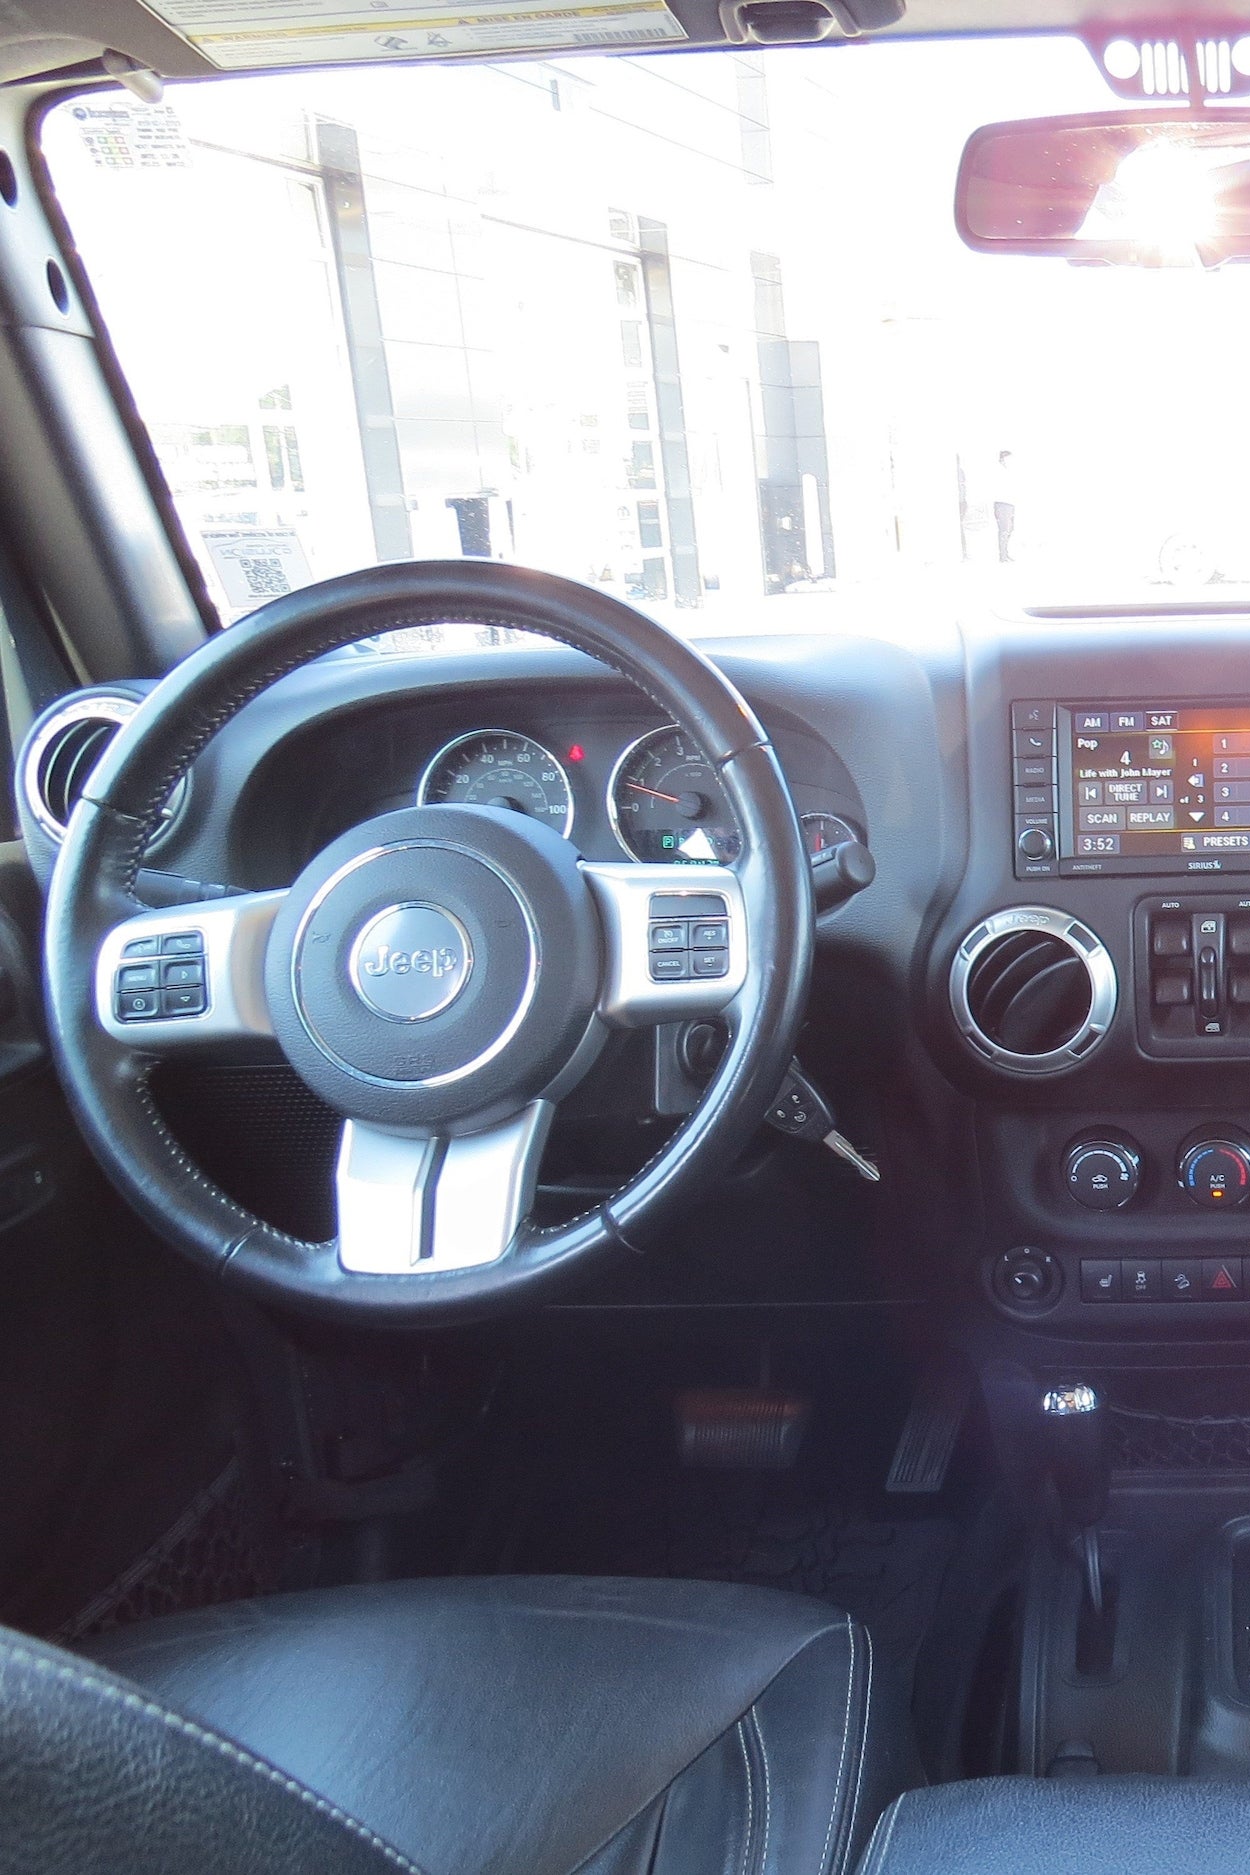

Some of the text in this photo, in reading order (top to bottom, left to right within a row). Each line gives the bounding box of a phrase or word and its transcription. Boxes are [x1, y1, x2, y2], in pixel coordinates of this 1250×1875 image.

[1084, 715, 1173, 728] AM FM SAT
[1077, 738, 1099, 751] Pop
[1221, 738, 1227, 749] 1
[676, 746, 684, 756] 3
[480, 755, 494, 764] 40
[517, 753, 531, 763] 60
[654, 758, 662, 767] 2
[1120, 750, 1132, 765] 4
[1221, 763, 1229, 773] 2
[541, 772, 556, 782] 80
[1079, 769, 1098, 779] Life
[1098, 768, 1119, 778] with
[1120, 768, 1141, 778] John
[456, 774, 470, 784] 20
[1108, 783, 1143, 793] DIRECT
[1221, 787, 1230, 797] 3
[1113, 792, 1140, 802] TUNE
[1197, 795, 1204, 804] 3
[548, 805, 567, 815] 100
[1087, 812, 1171, 824] SCAN REPLAY
[1222, 812, 1230, 822] 4
[1083, 838, 1114, 851] 3:52
[1203, 836, 1249, 847] PRESETS
[364, 944, 458, 977] Jeep
[657, 960, 681, 968] CANCEL
[1210, 1174, 1225, 1183] A/C
